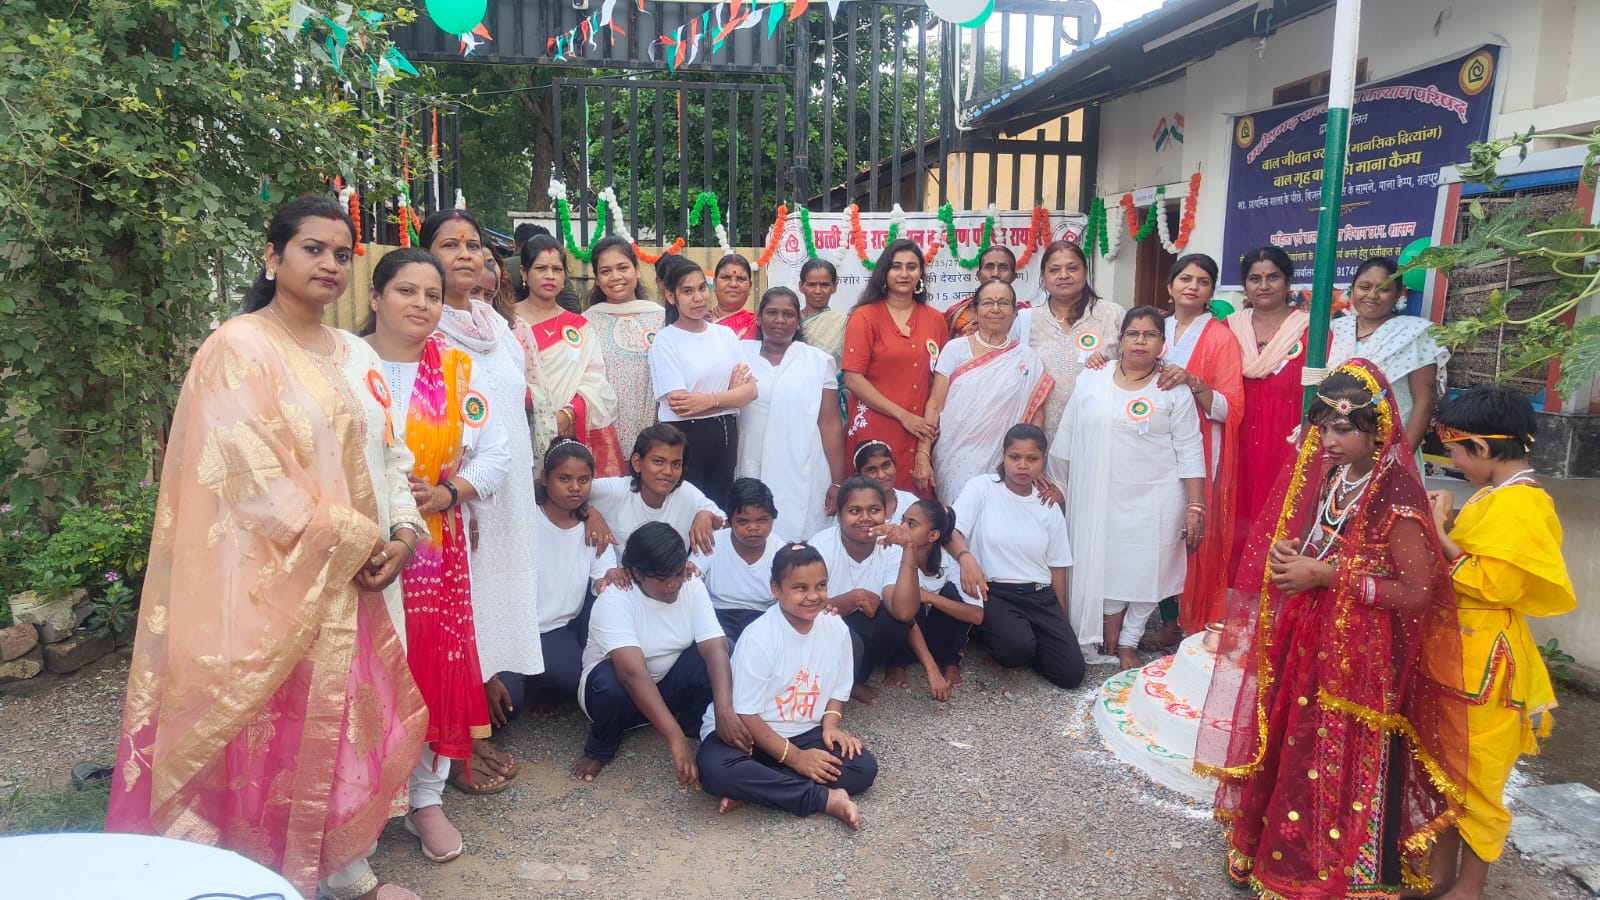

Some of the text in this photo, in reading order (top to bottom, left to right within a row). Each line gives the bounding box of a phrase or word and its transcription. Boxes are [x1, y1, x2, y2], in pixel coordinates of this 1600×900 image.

[1262, 157, 1280, 170] बाल
[1281, 150, 1312, 166] जीवन
[1273, 174, 1293, 187] बाल
[1293, 170, 1312, 188] गृह
[1355, 157, 1388, 173] माना
[1388, 151, 1423, 168] कैम्प
[1379, 179, 1396, 191] माना
[1417, 173, 1439, 188] रायपुर
[940, 271, 972, 283] देखरेख
